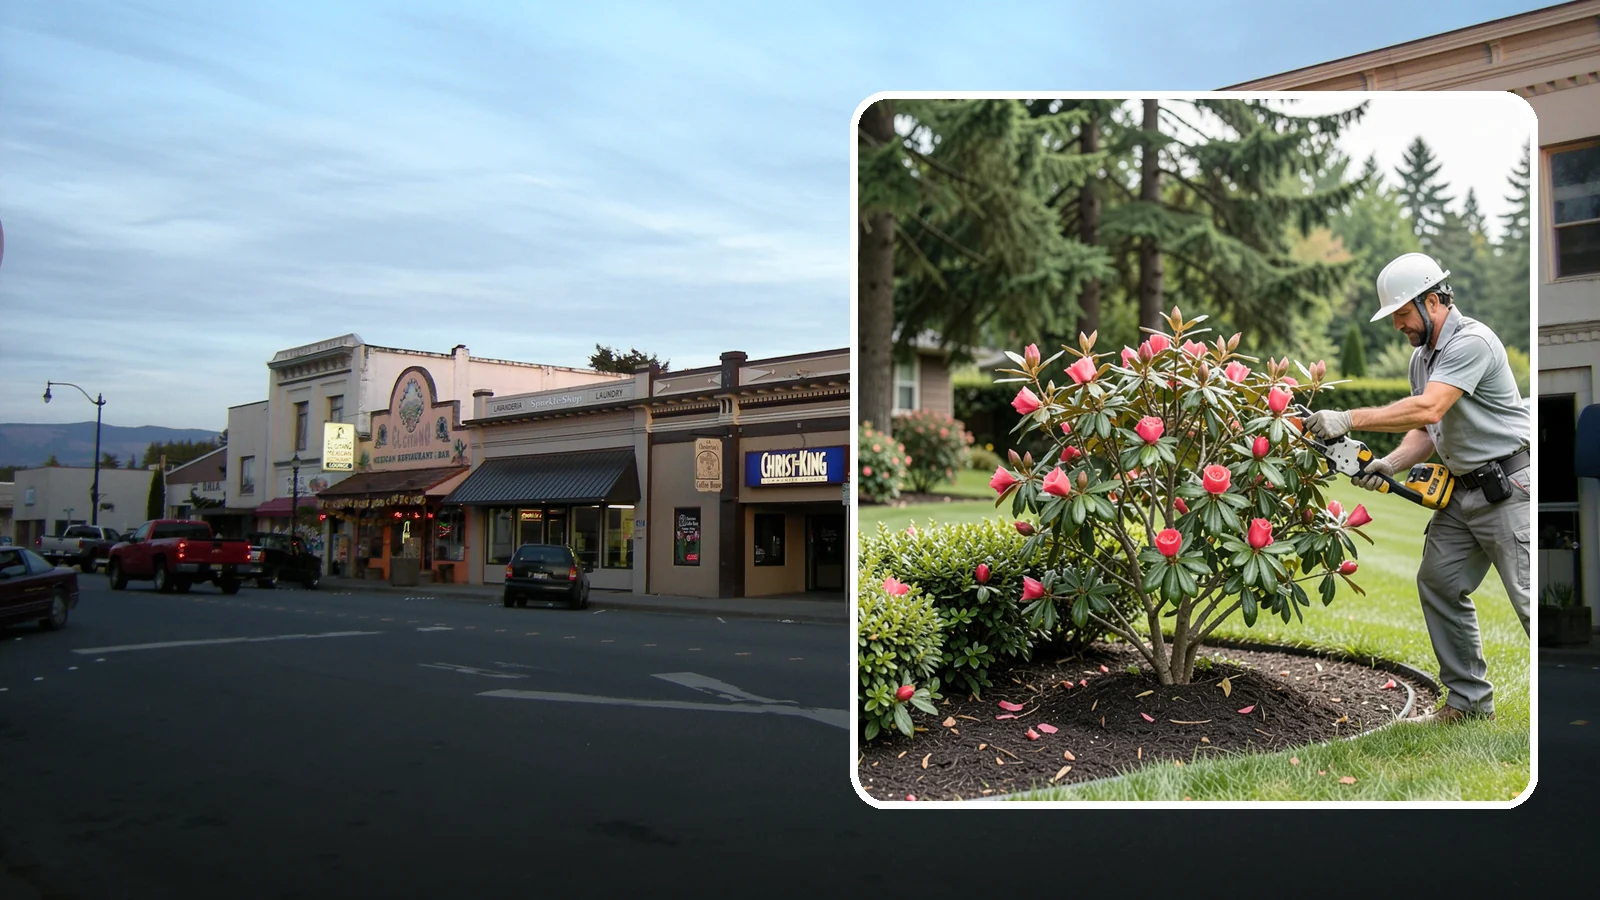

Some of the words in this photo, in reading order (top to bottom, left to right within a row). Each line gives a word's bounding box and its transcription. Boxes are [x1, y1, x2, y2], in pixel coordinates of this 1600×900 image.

[561, 394, 582, 406] Shop
[595, 388, 623, 400] LAUNDRY
[493, 402, 523, 413] LAVANDERIA
[373, 454, 396, 464] MEXICAN
[397, 451, 433, 462] RESTAURANT
[437, 450, 450, 459] BAR
[761, 452, 797, 478] CHRIST
[799, 450, 827, 476] KING
